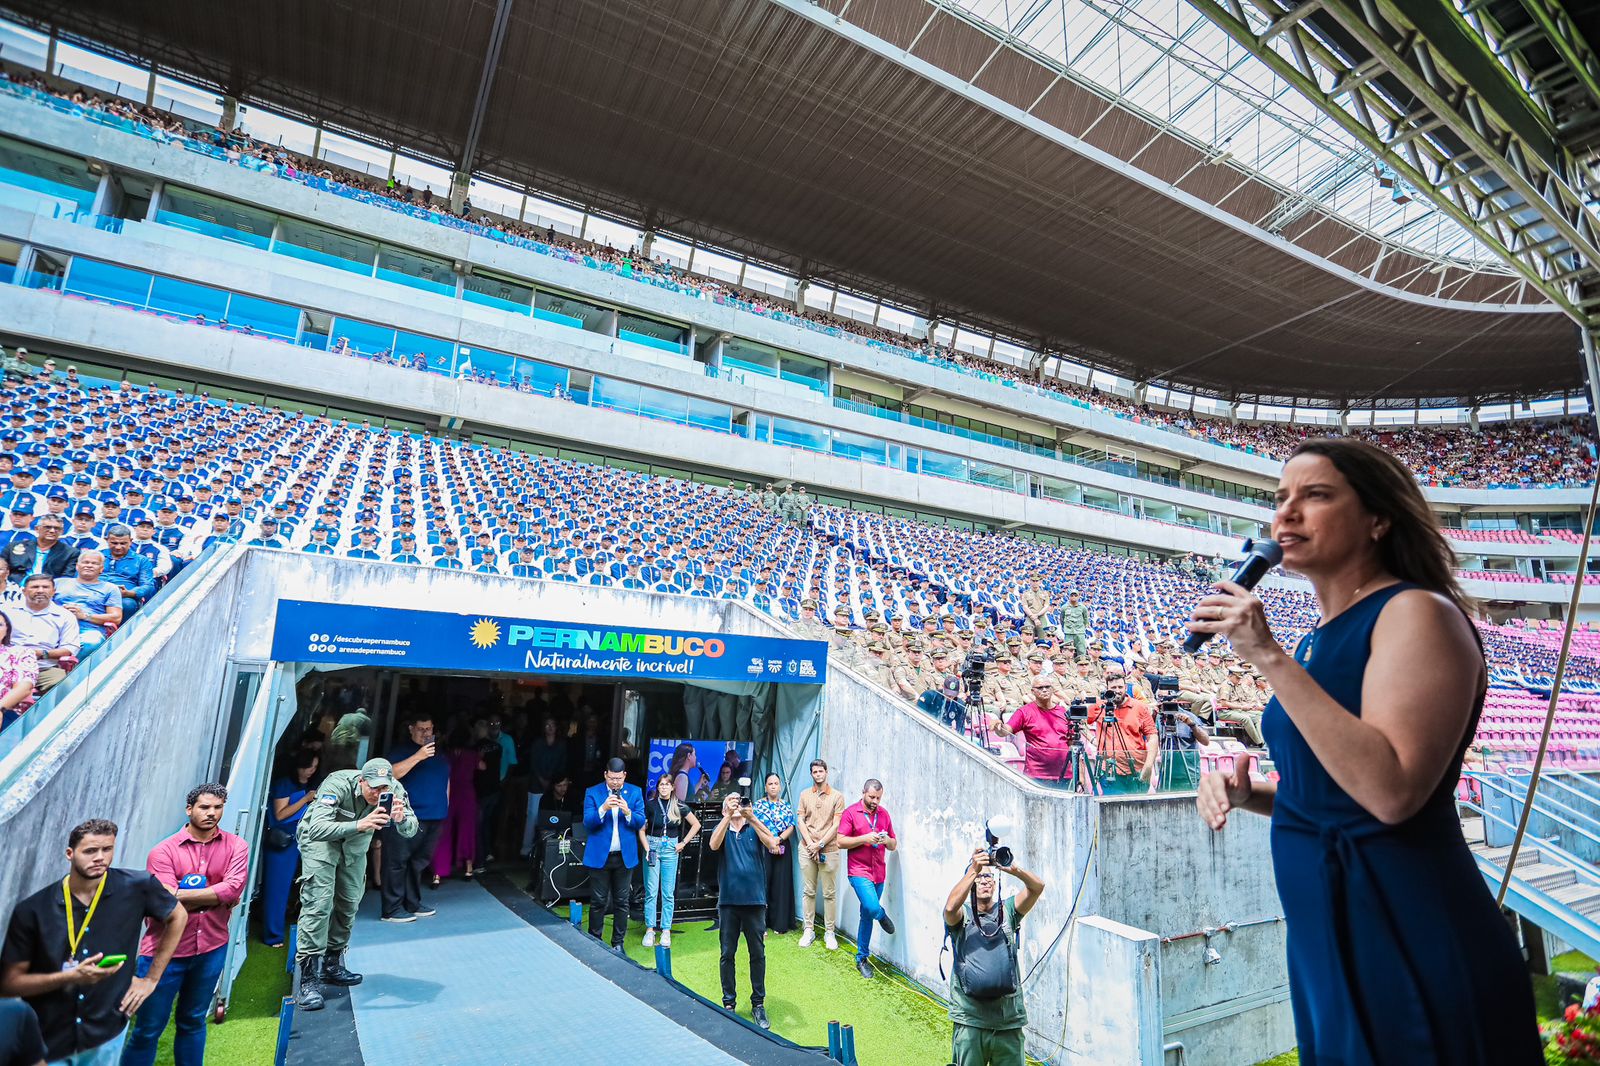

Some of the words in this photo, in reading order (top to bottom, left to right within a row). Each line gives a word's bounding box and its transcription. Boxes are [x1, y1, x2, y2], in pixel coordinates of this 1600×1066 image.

[333, 635, 411, 646] /descubraepernambuco
[507, 625, 725, 658] PERNAMBUCO
[339, 647, 406, 656] arenadepernambuco
[525, 650, 633, 672] Naturalmente
[636, 658, 695, 674] incrível!
